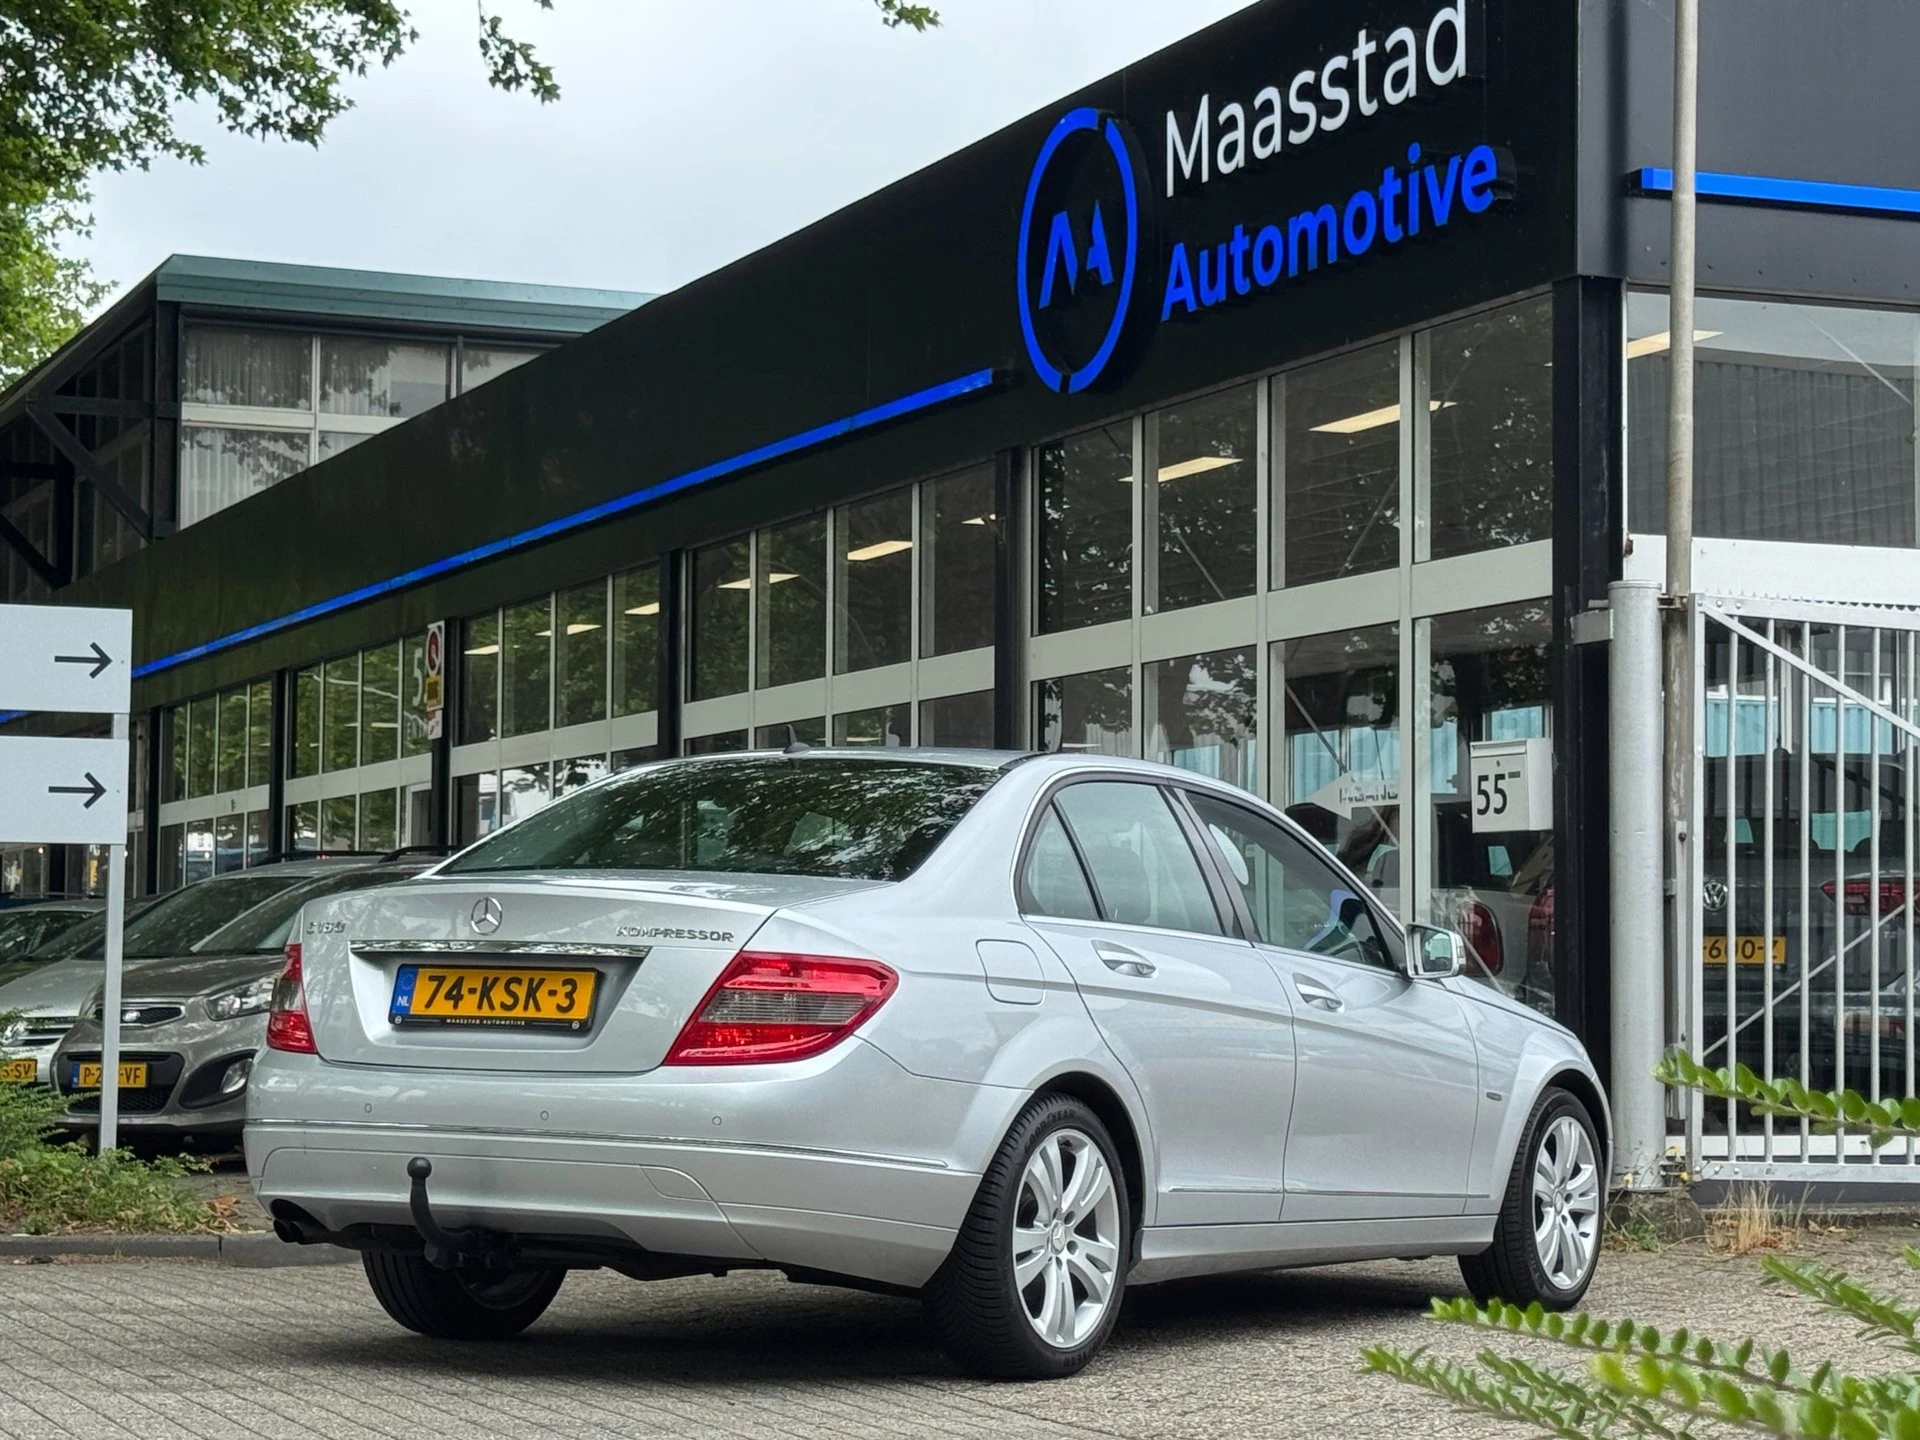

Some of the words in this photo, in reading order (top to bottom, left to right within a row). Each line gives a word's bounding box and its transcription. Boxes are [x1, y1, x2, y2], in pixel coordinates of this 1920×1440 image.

[1166, 0, 1467, 198] Maasstad
[1161, 142, 1498, 323] Automotive
[1476, 773, 1508, 816] 55
[616, 926, 735, 943] KOMPRESSOR
[396, 995, 410, 1007] NL
[424, 974, 578, 1014] 74-KSK-3
[83, 1066, 142, 1085] P-2-VF
